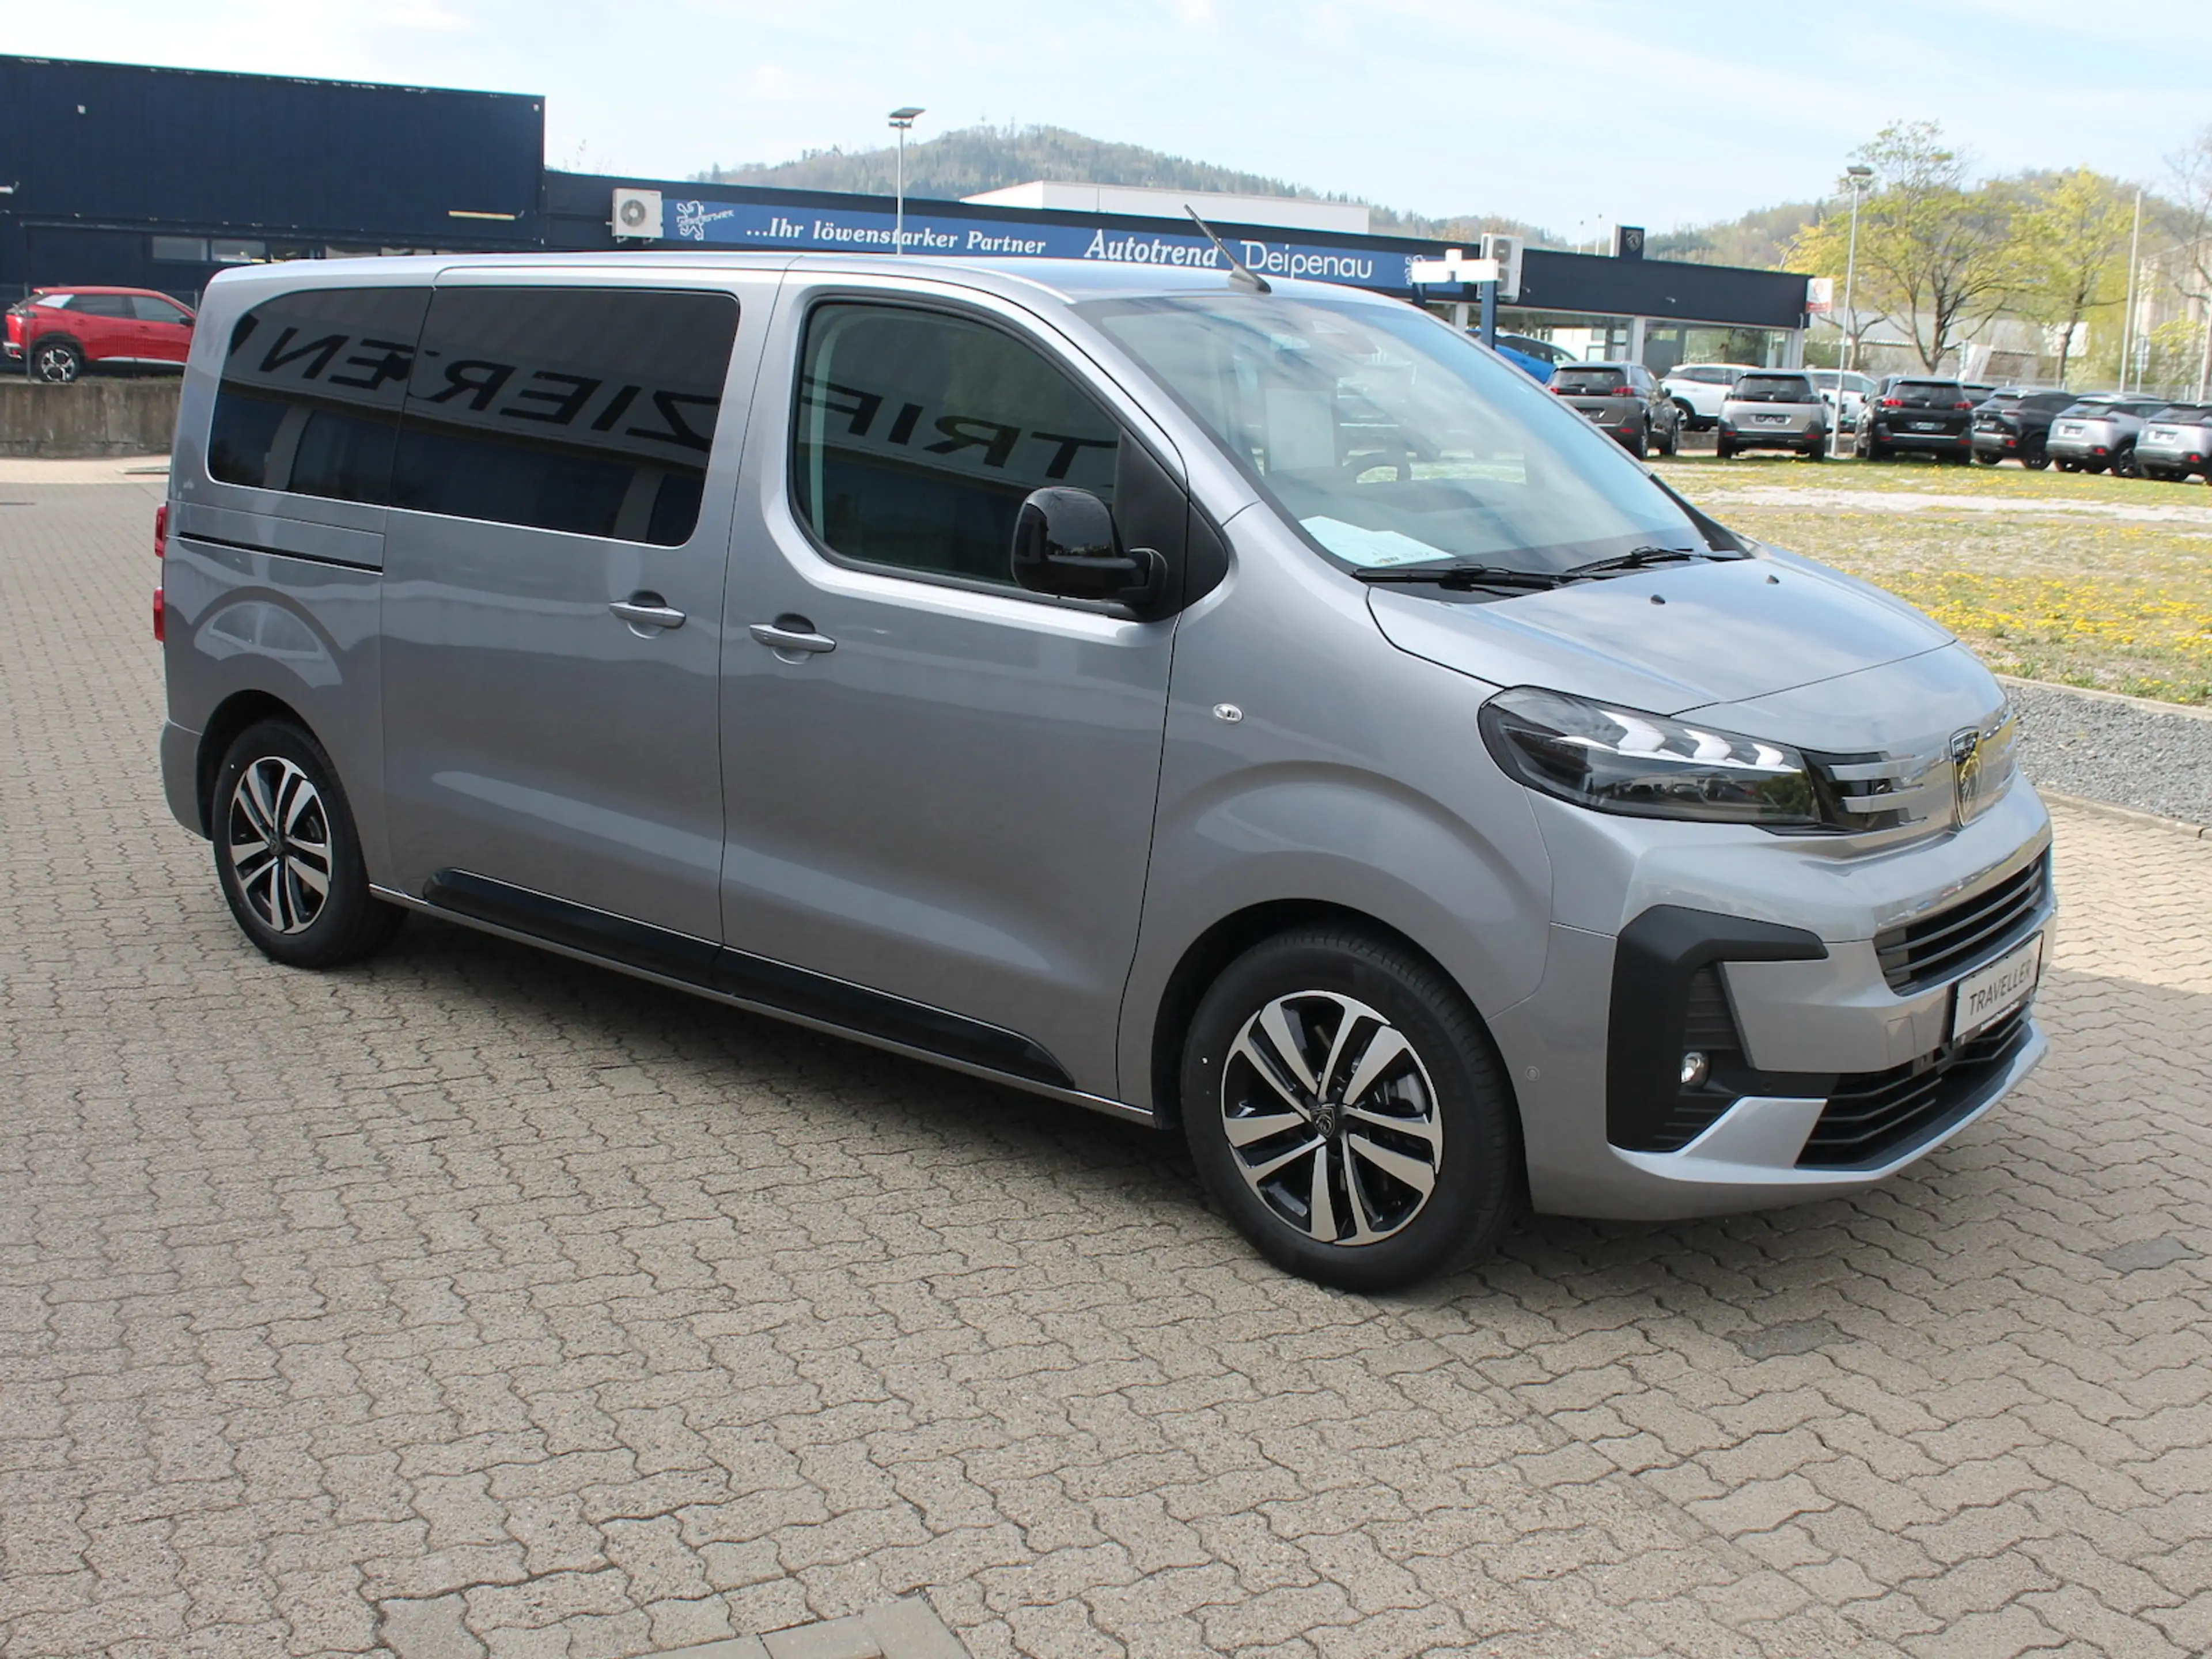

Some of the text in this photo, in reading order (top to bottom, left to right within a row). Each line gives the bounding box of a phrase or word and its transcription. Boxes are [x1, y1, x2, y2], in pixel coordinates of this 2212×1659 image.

[813, 220, 958, 248] löwenstarker
[966, 231, 1046, 254] Partner
[1085, 229, 1372, 279] Autotrend Deipenau
[1969, 959, 2032, 1016] TRAVELLER
